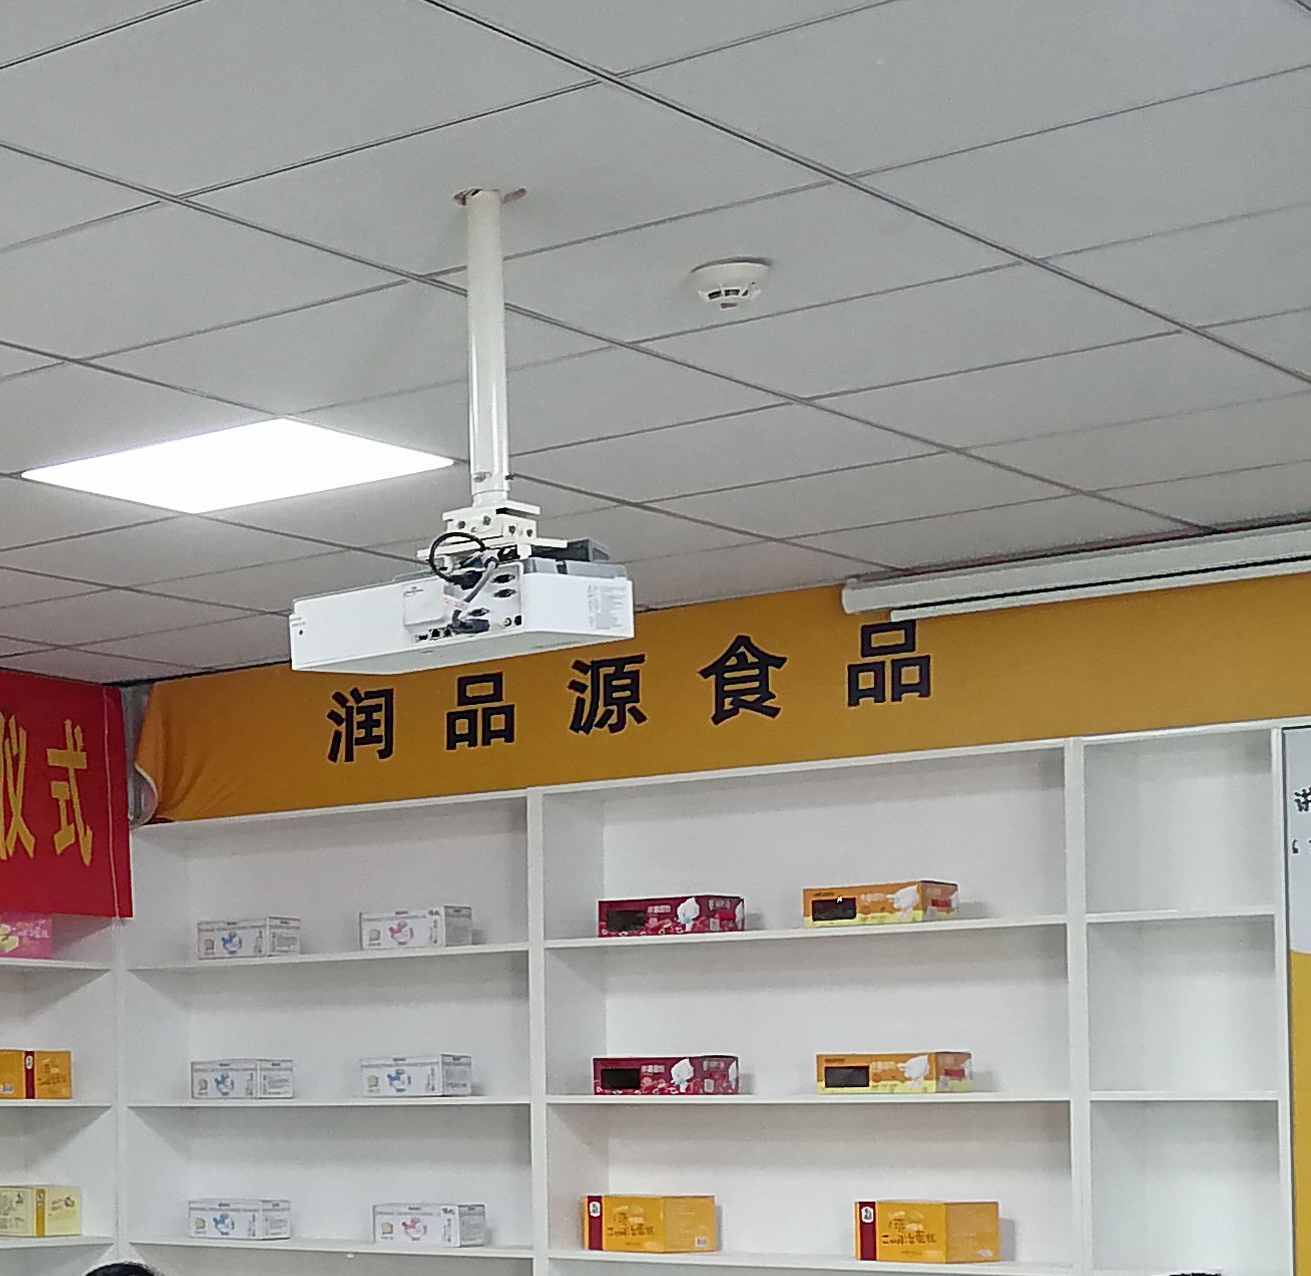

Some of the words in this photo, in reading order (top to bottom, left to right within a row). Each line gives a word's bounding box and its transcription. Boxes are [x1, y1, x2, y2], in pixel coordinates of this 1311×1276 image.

[325, 621, 932, 764] 润品源食品
